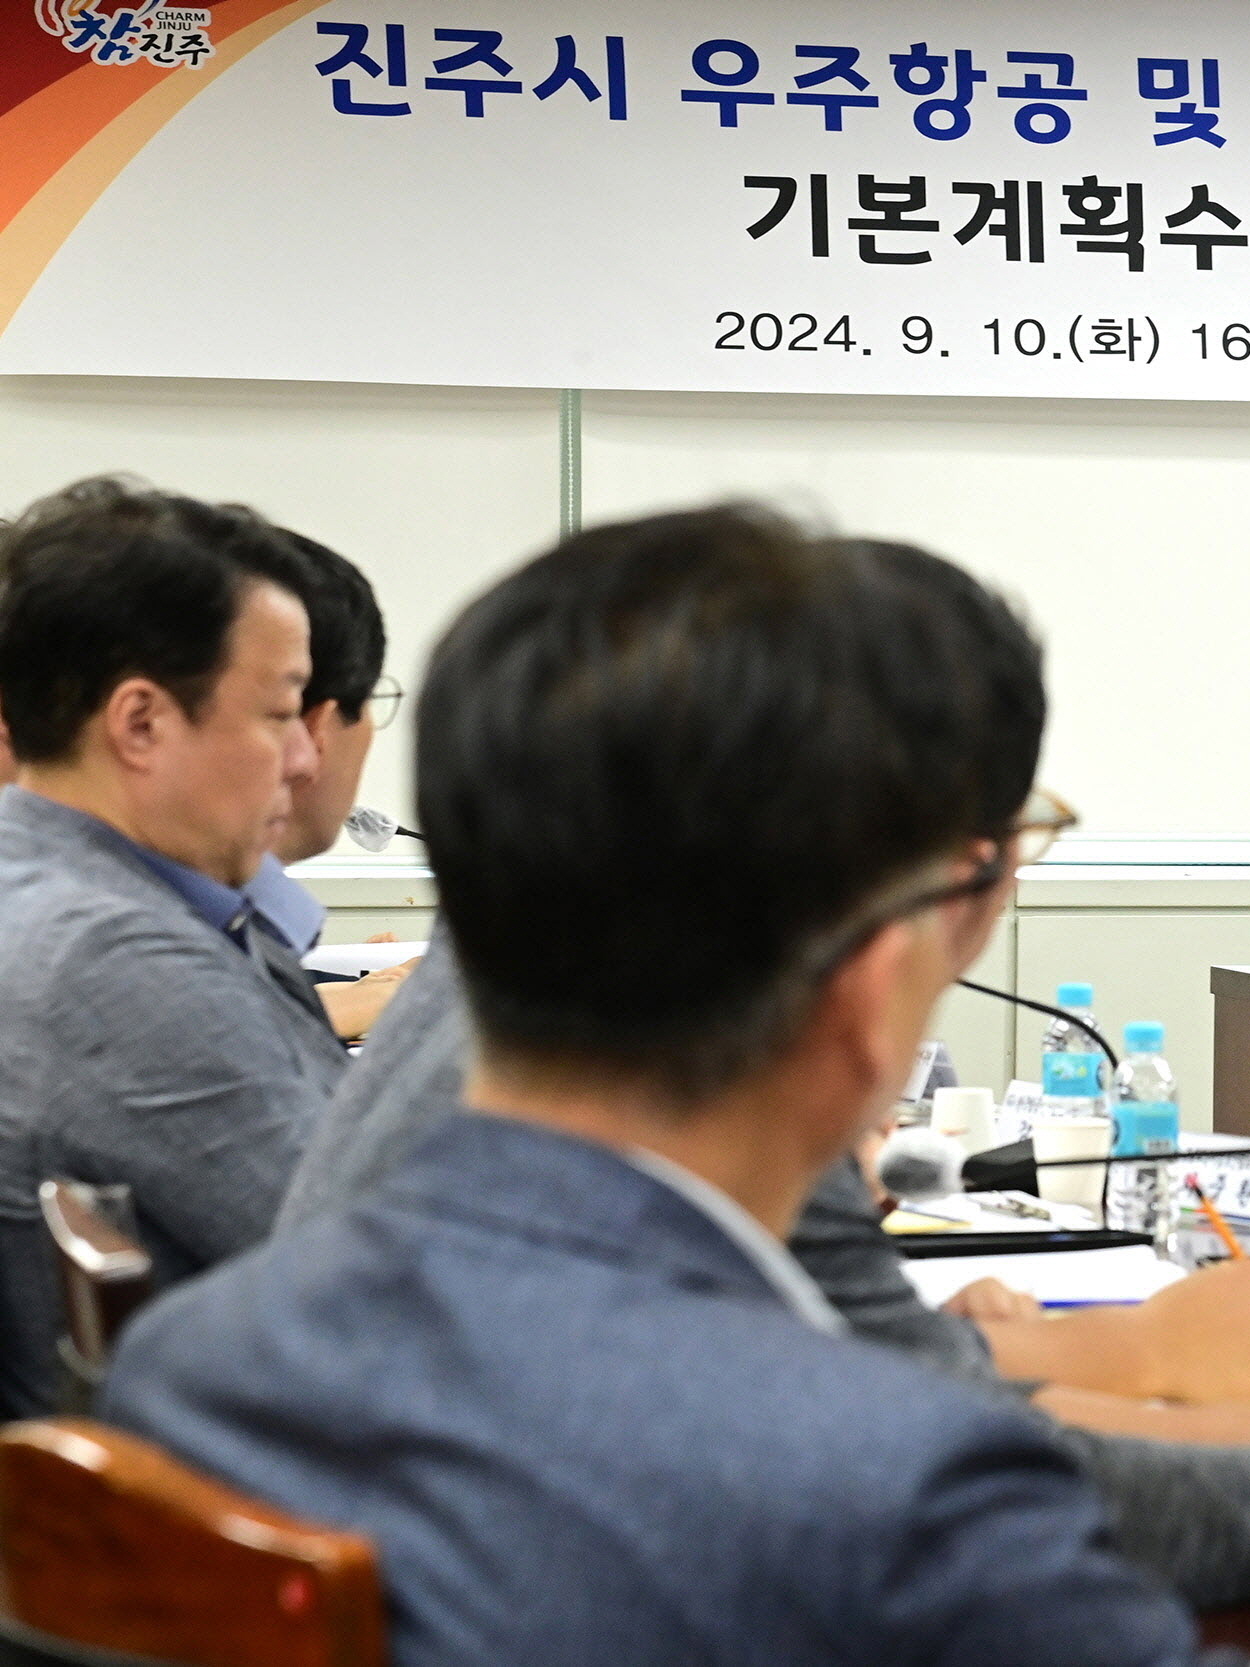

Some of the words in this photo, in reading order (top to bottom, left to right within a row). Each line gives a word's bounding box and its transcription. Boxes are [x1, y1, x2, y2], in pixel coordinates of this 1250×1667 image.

[69, 10, 141, 60] 참
[139, 33, 210, 65] 진주
[155, 11, 206, 22] CHARM
[156, 21, 192, 31] JINJU
[315, 22, 627, 120] 진주시
[681, 39, 1087, 144] 우주항공
[1138, 58, 1226, 148] 및
[715, 312, 871, 355] 2024.
[902, 316, 948, 357] 9.
[985, 315, 1159, 364] 10.(화)
